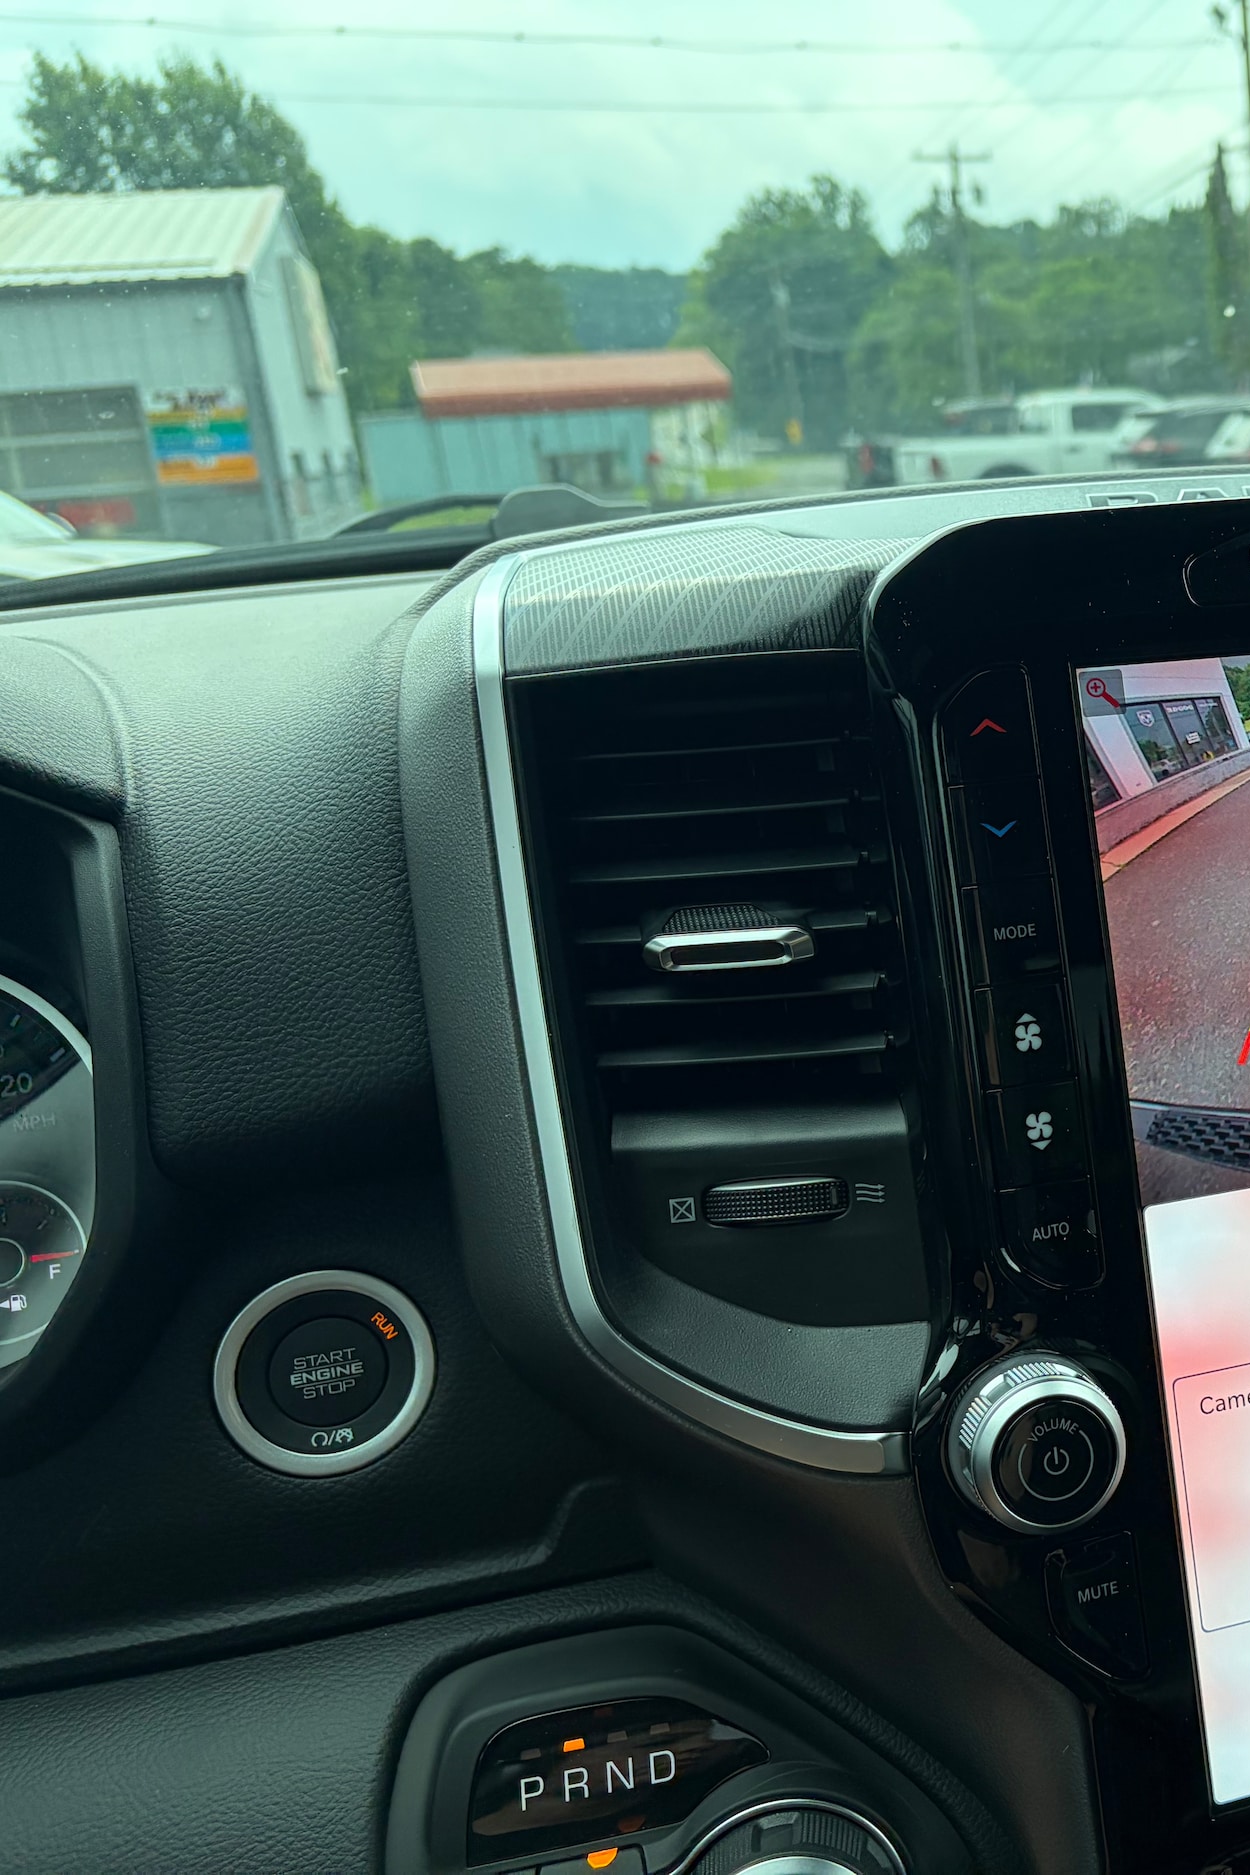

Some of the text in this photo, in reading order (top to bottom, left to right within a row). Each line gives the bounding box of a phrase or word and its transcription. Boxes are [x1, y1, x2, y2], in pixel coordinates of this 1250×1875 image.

[993, 923, 1037, 941] MODE
[13, 1112, 56, 1133] MPH
[1031, 1221, 1070, 1242] AUTO
[49, 1263, 62, 1280] F
[370, 1311, 400, 1341] RUN
[293, 1347, 357, 1371] START
[289, 1361, 365, 1386] ENGINE
[303, 1379, 356, 1400] STOP
[1027, 1418, 1080, 1444] VOLUME
[1077, 1580, 1120, 1604] MUTE
